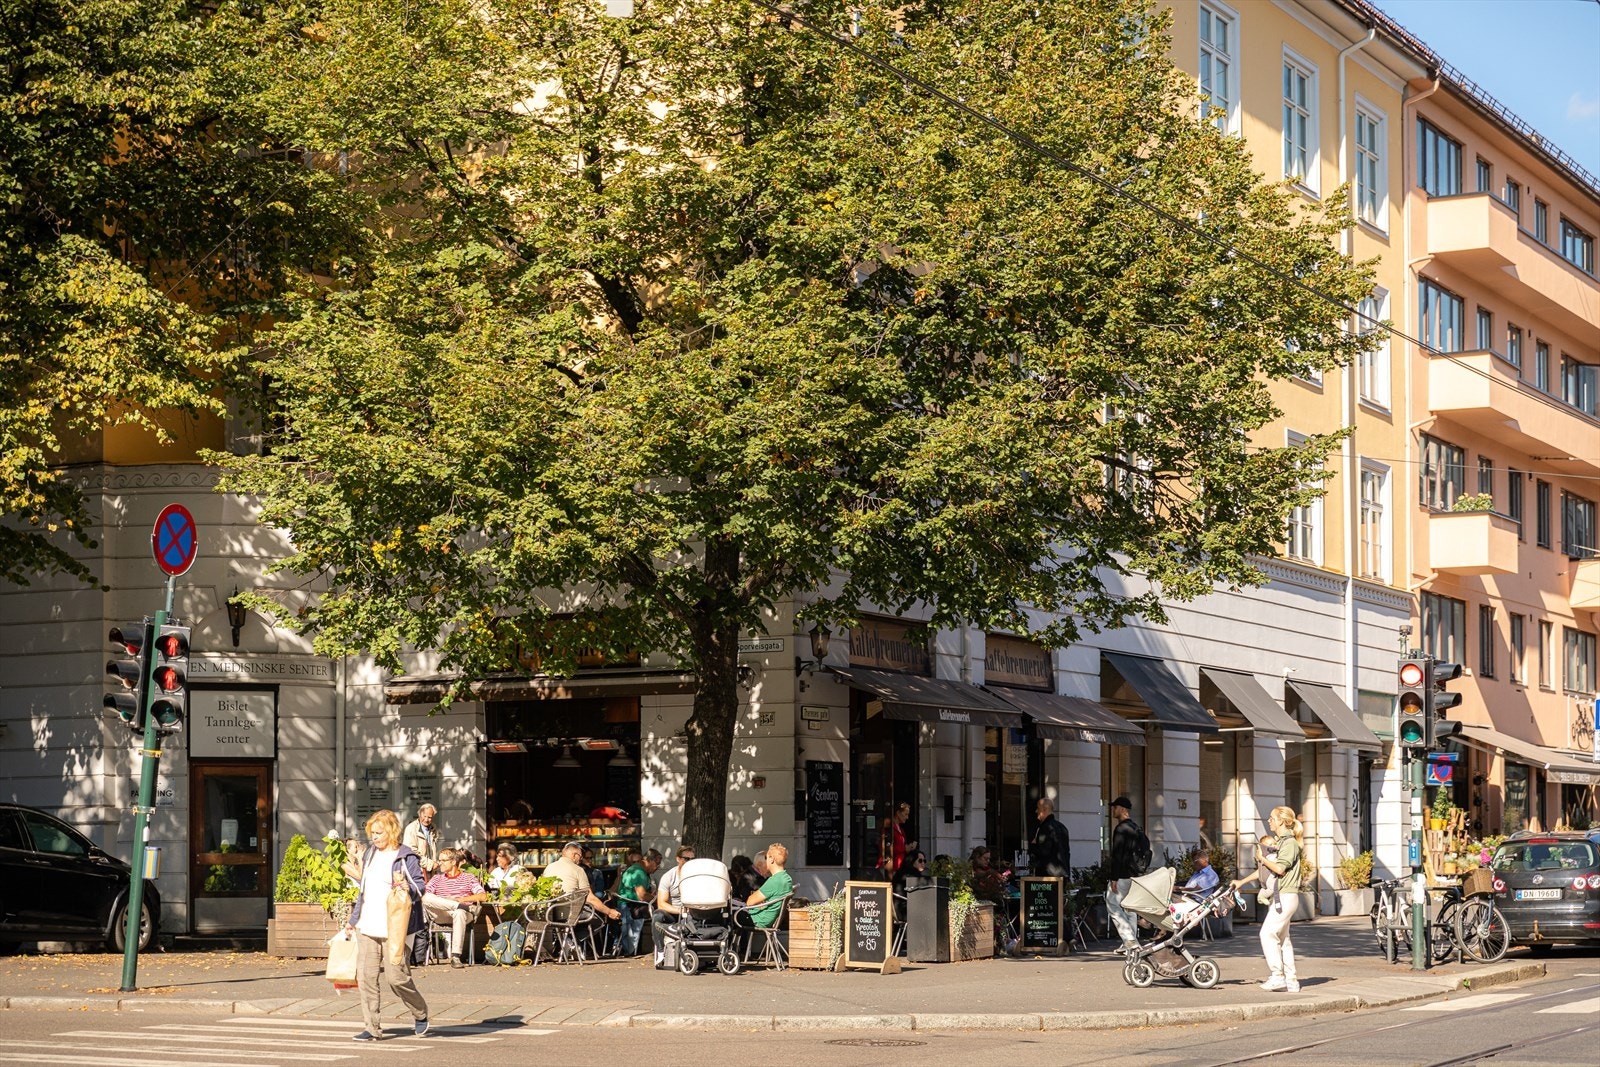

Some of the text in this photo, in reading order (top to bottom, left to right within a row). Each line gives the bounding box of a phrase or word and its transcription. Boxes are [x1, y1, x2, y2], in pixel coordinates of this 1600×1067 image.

[212, 662, 286, 674] MEDISINSKE
[289, 663, 328, 676] SENTER
[218, 700, 249, 711] Bislet
[204, 716, 262, 731] Tannlege-
[216, 735, 250, 744] senter
[130, 790, 173, 798] PAING
[1538, 890, 1559, 898] 19601
[865, 938, 877, 951] 85
